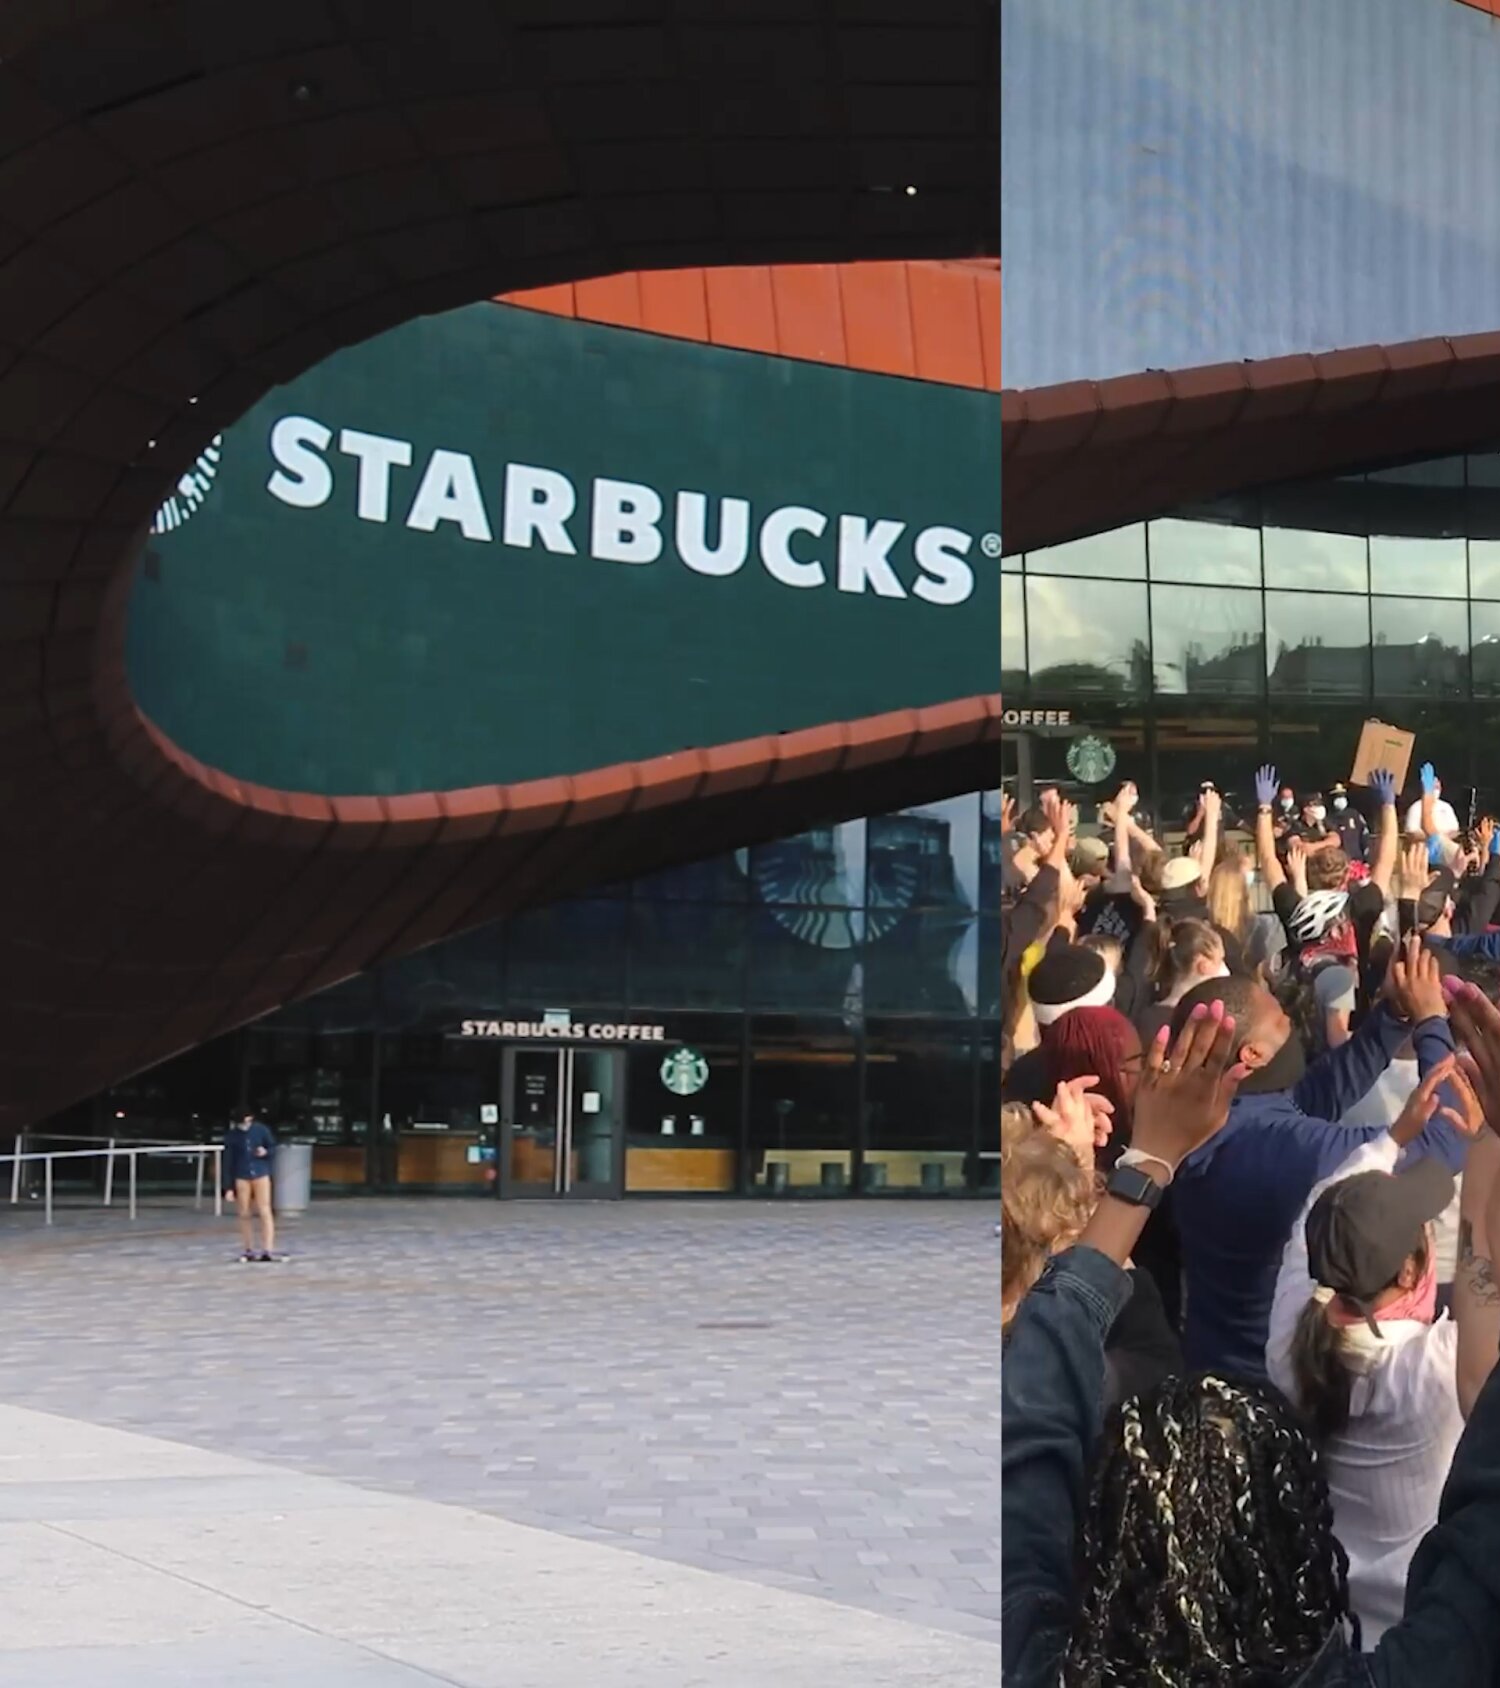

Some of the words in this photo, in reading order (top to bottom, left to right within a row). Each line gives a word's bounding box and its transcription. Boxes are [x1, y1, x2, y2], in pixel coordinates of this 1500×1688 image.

[267, 415, 974, 606] STARBUCKS
[1001, 709, 1071, 726] OFFEE
[461, 1020, 585, 1038] STARBUCKS
[588, 1023, 665, 1040] COFFEE
